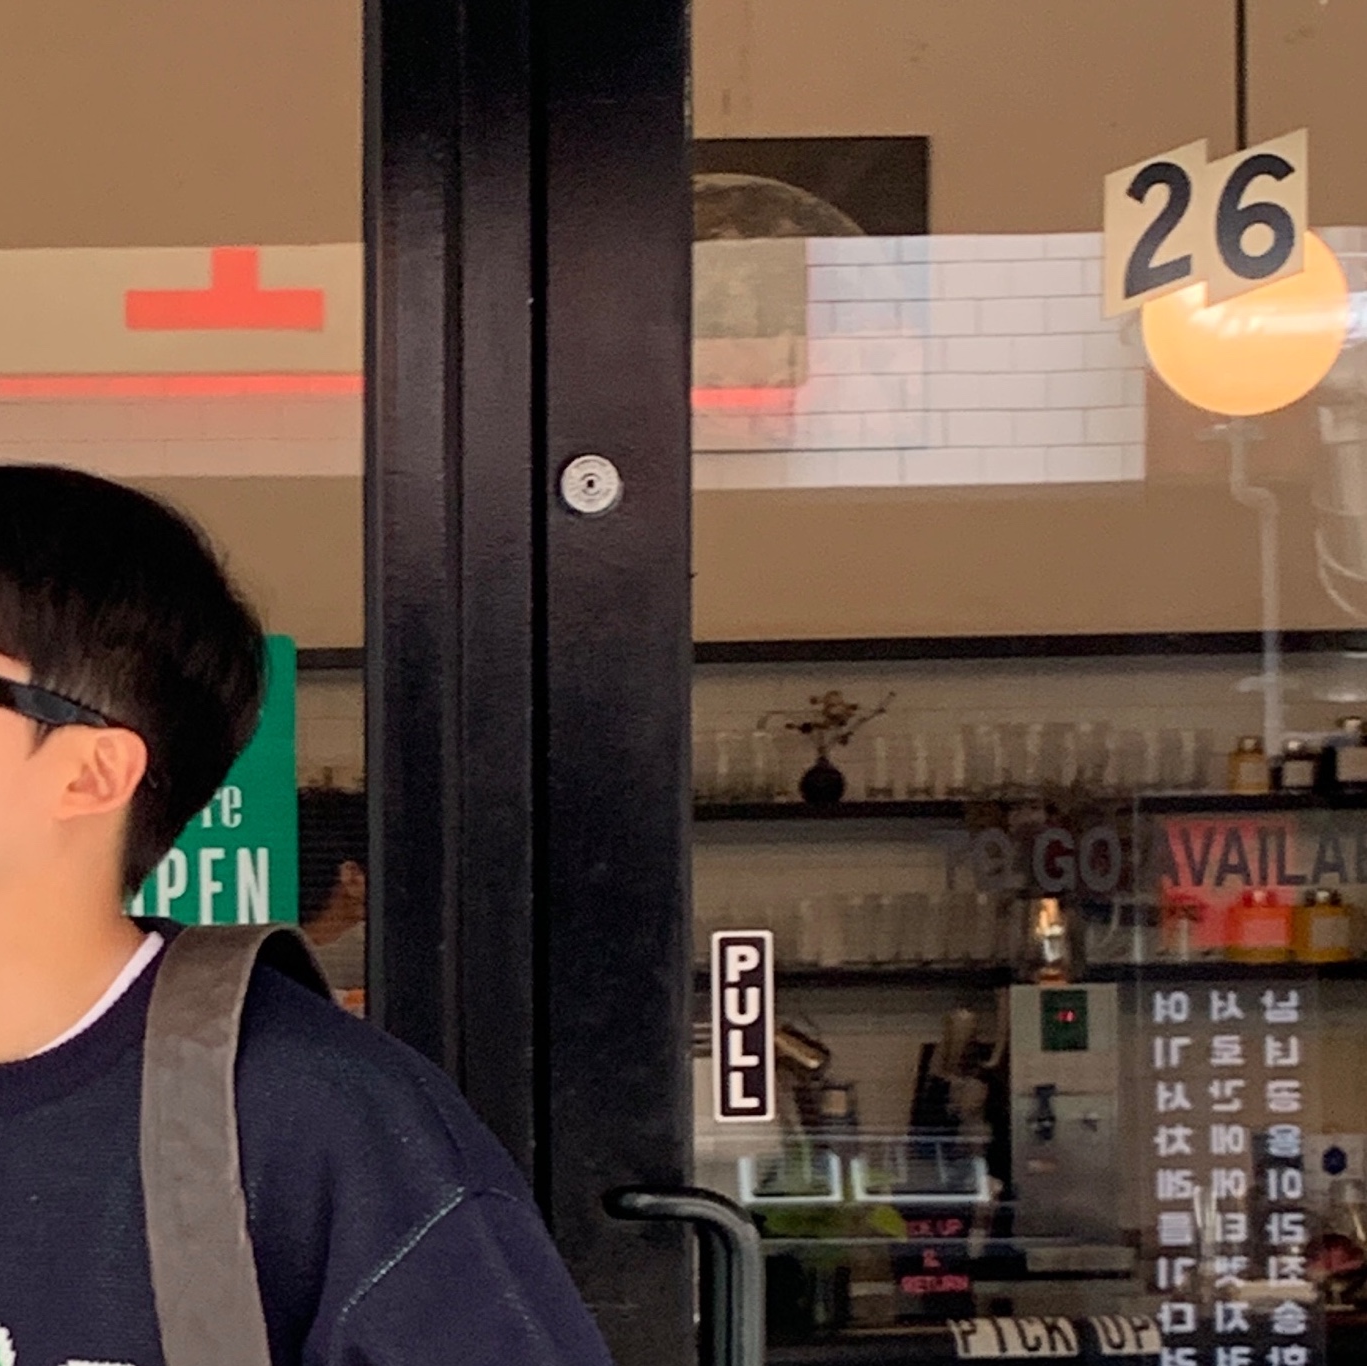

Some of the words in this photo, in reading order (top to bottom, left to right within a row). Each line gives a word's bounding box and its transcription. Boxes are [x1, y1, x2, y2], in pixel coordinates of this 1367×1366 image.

[1124, 152, 1296, 300] 26
[200, 785, 243, 828] re
[130, 846, 270, 925] PEN
[1032, 826, 1122, 893] GO
[723, 944, 760, 1110] PULL
[954, 1316, 1076, 1354] PICK
[1095, 1315, 1152, 1351] UP
